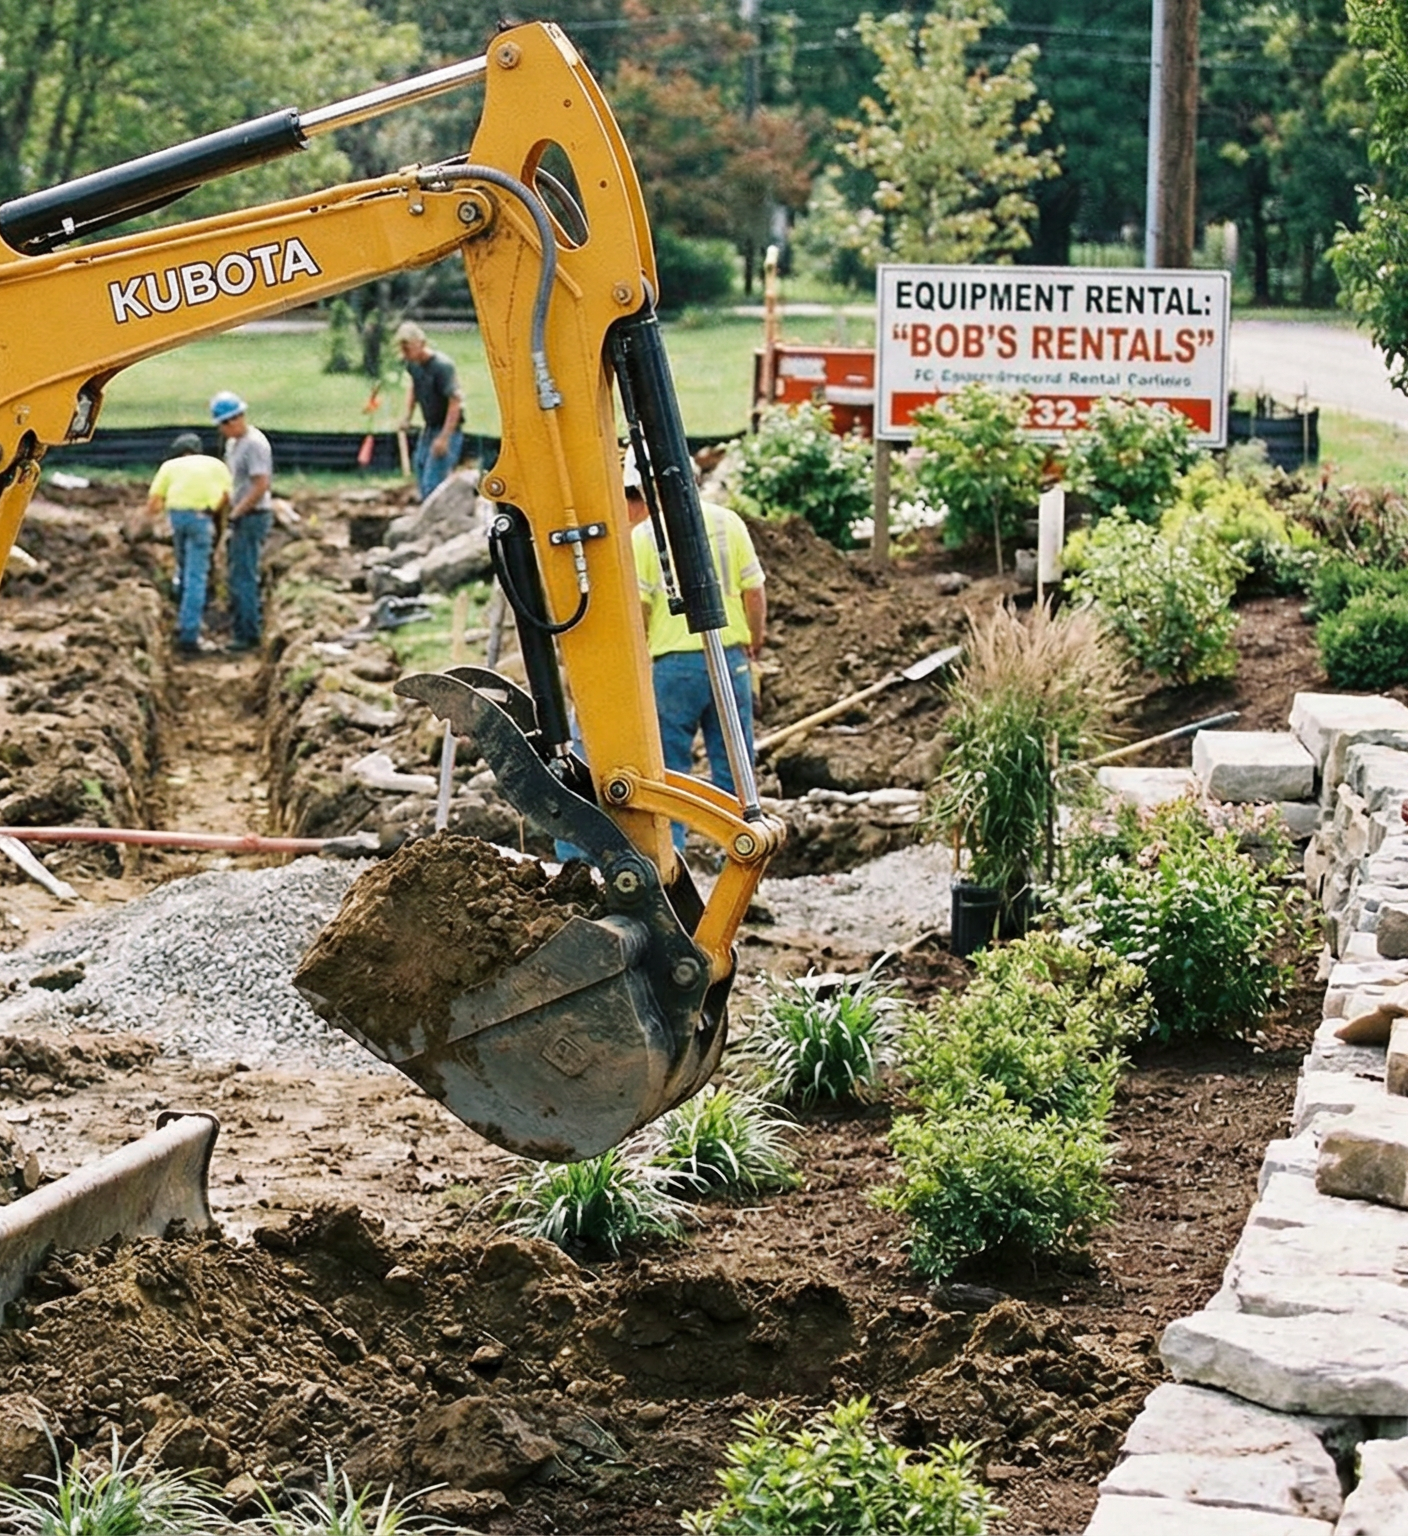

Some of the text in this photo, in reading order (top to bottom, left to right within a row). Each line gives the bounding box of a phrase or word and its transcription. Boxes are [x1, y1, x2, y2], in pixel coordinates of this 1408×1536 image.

[108, 236, 323, 324] KUBOTA
[896, 281, 1211, 316] EQUIPMENT RENTAL:
[1069, 371, 1121, 386] Rental
